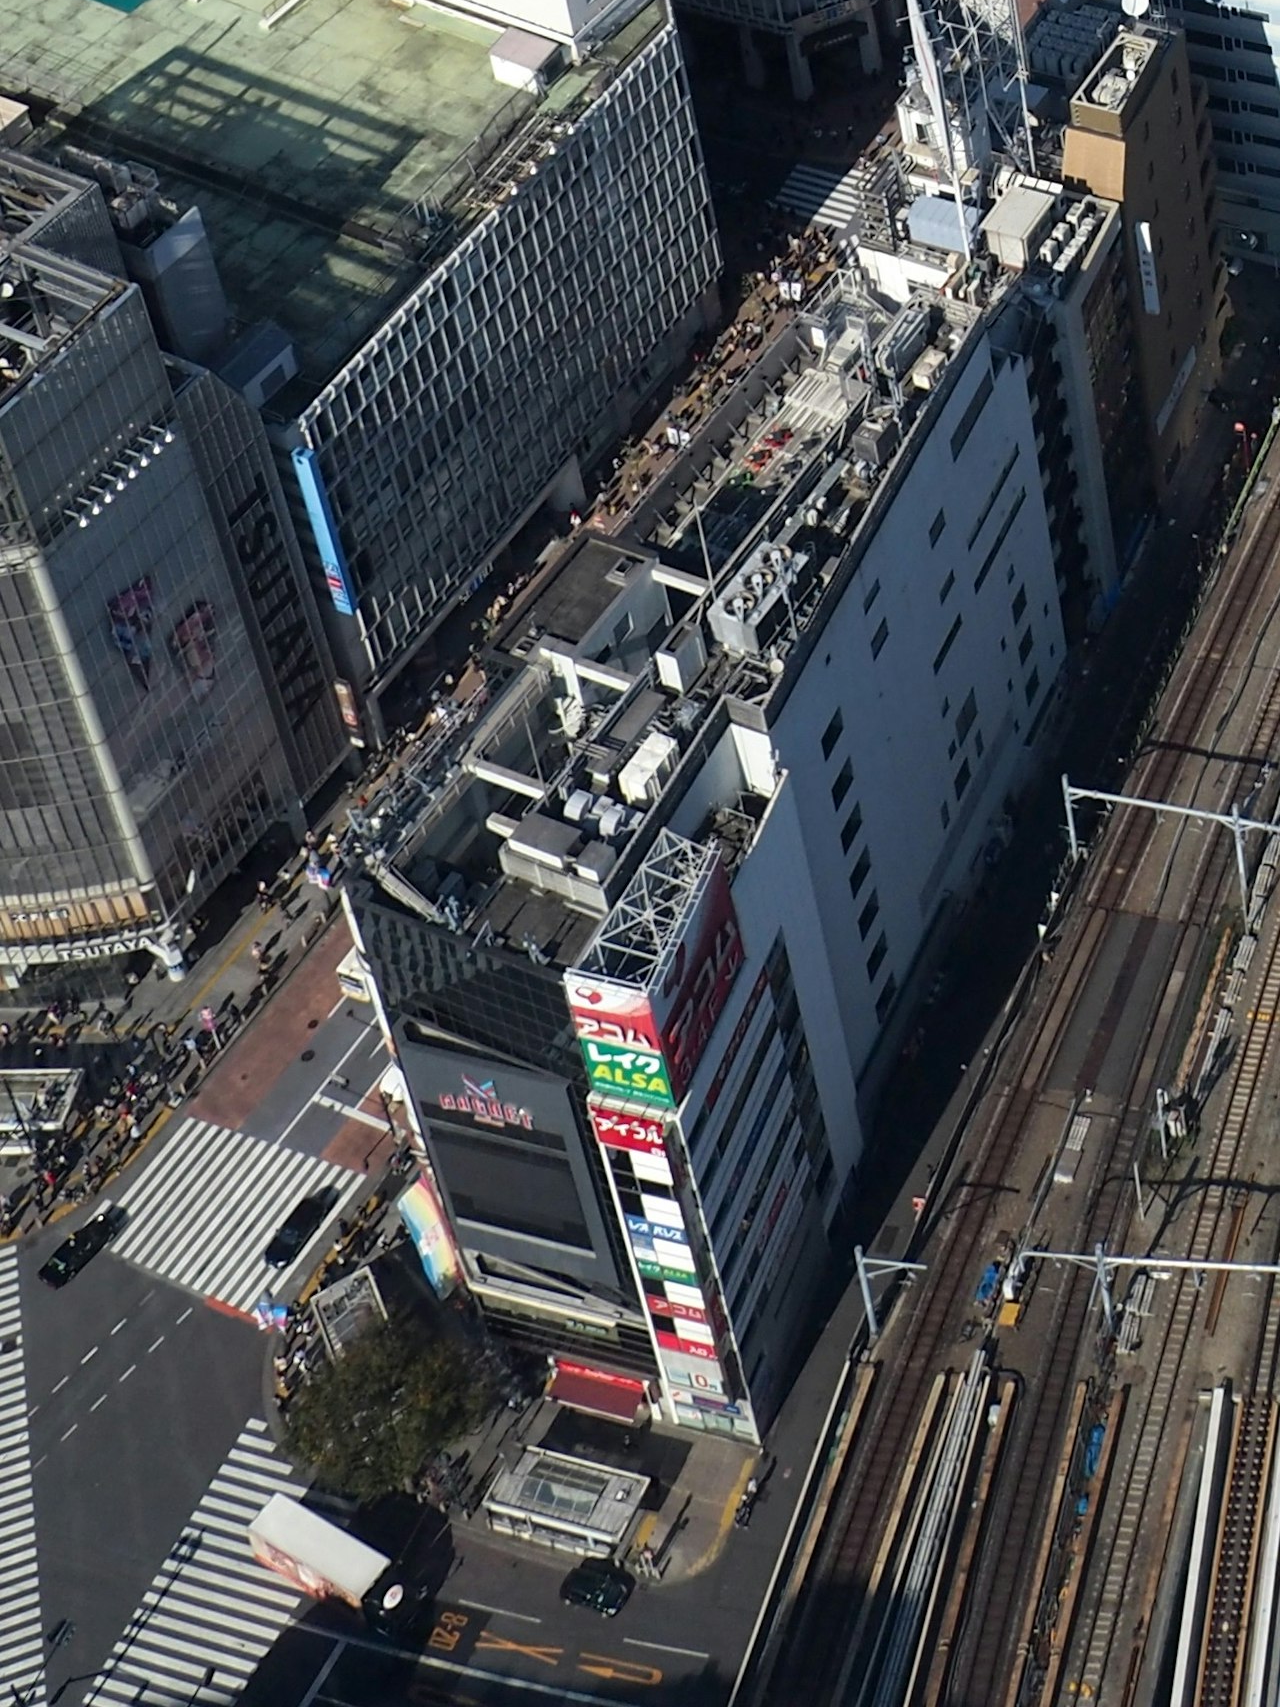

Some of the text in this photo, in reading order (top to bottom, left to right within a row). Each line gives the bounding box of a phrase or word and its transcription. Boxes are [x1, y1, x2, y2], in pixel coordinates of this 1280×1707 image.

[230, 471, 324, 729] TSUTAYA
[60, 937, 153, 962] TSUTAYA
[575, 1015, 651, 1049] アコム
[587, 1041, 661, 1075] レイク
[593, 1063, 668, 1096] ALSA
[594, 1115, 663, 1144] アイフル
[654, 1299, 702, 1319] アコム
